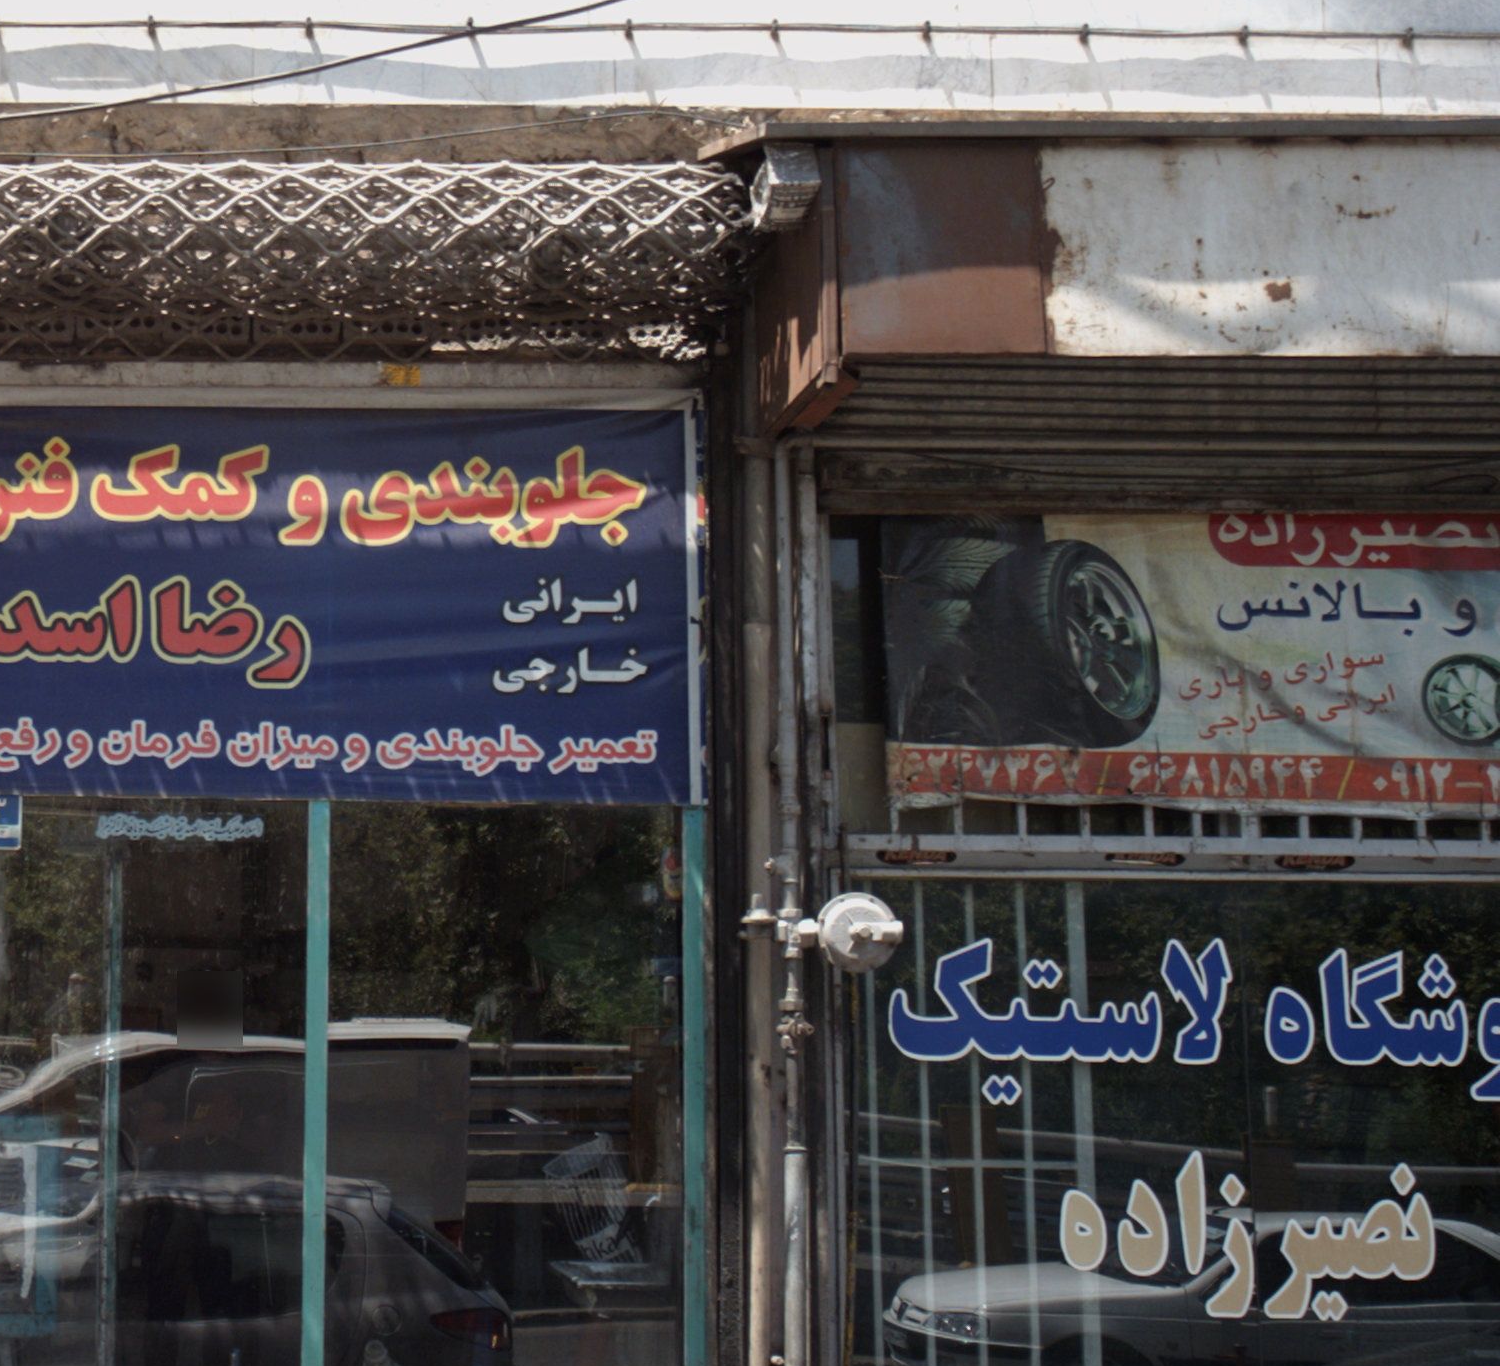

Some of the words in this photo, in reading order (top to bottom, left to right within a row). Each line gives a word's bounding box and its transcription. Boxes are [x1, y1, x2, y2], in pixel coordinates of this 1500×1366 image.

[90, 443, 270, 522] کمک
[340, 445, 647, 548] جلوبندی
[277, 474, 328, 546] و
[502, 577, 639, 625] ایرانی
[1216, 579, 1422, 637] بالانس
[1442, 598, 1477, 637] و
[151, 575, 311, 689] رضا
[493, 645, 648, 694] خارجی
[1178, 666, 1246, 700] باری
[1284, 651, 1385, 685] سواری
[64, 728, 93, 769] و
[99, 719, 220, 769] فرمان
[226, 720, 337, 770] میزان
[341, 732, 370, 772] و
[376, 724, 544, 777] جلوبندی
[548, 729, 658, 774] تعمیر
[888, 937, 1233, 1106] لاستیک
[1060, 1149, 1436, 1322] نصیرزاده
